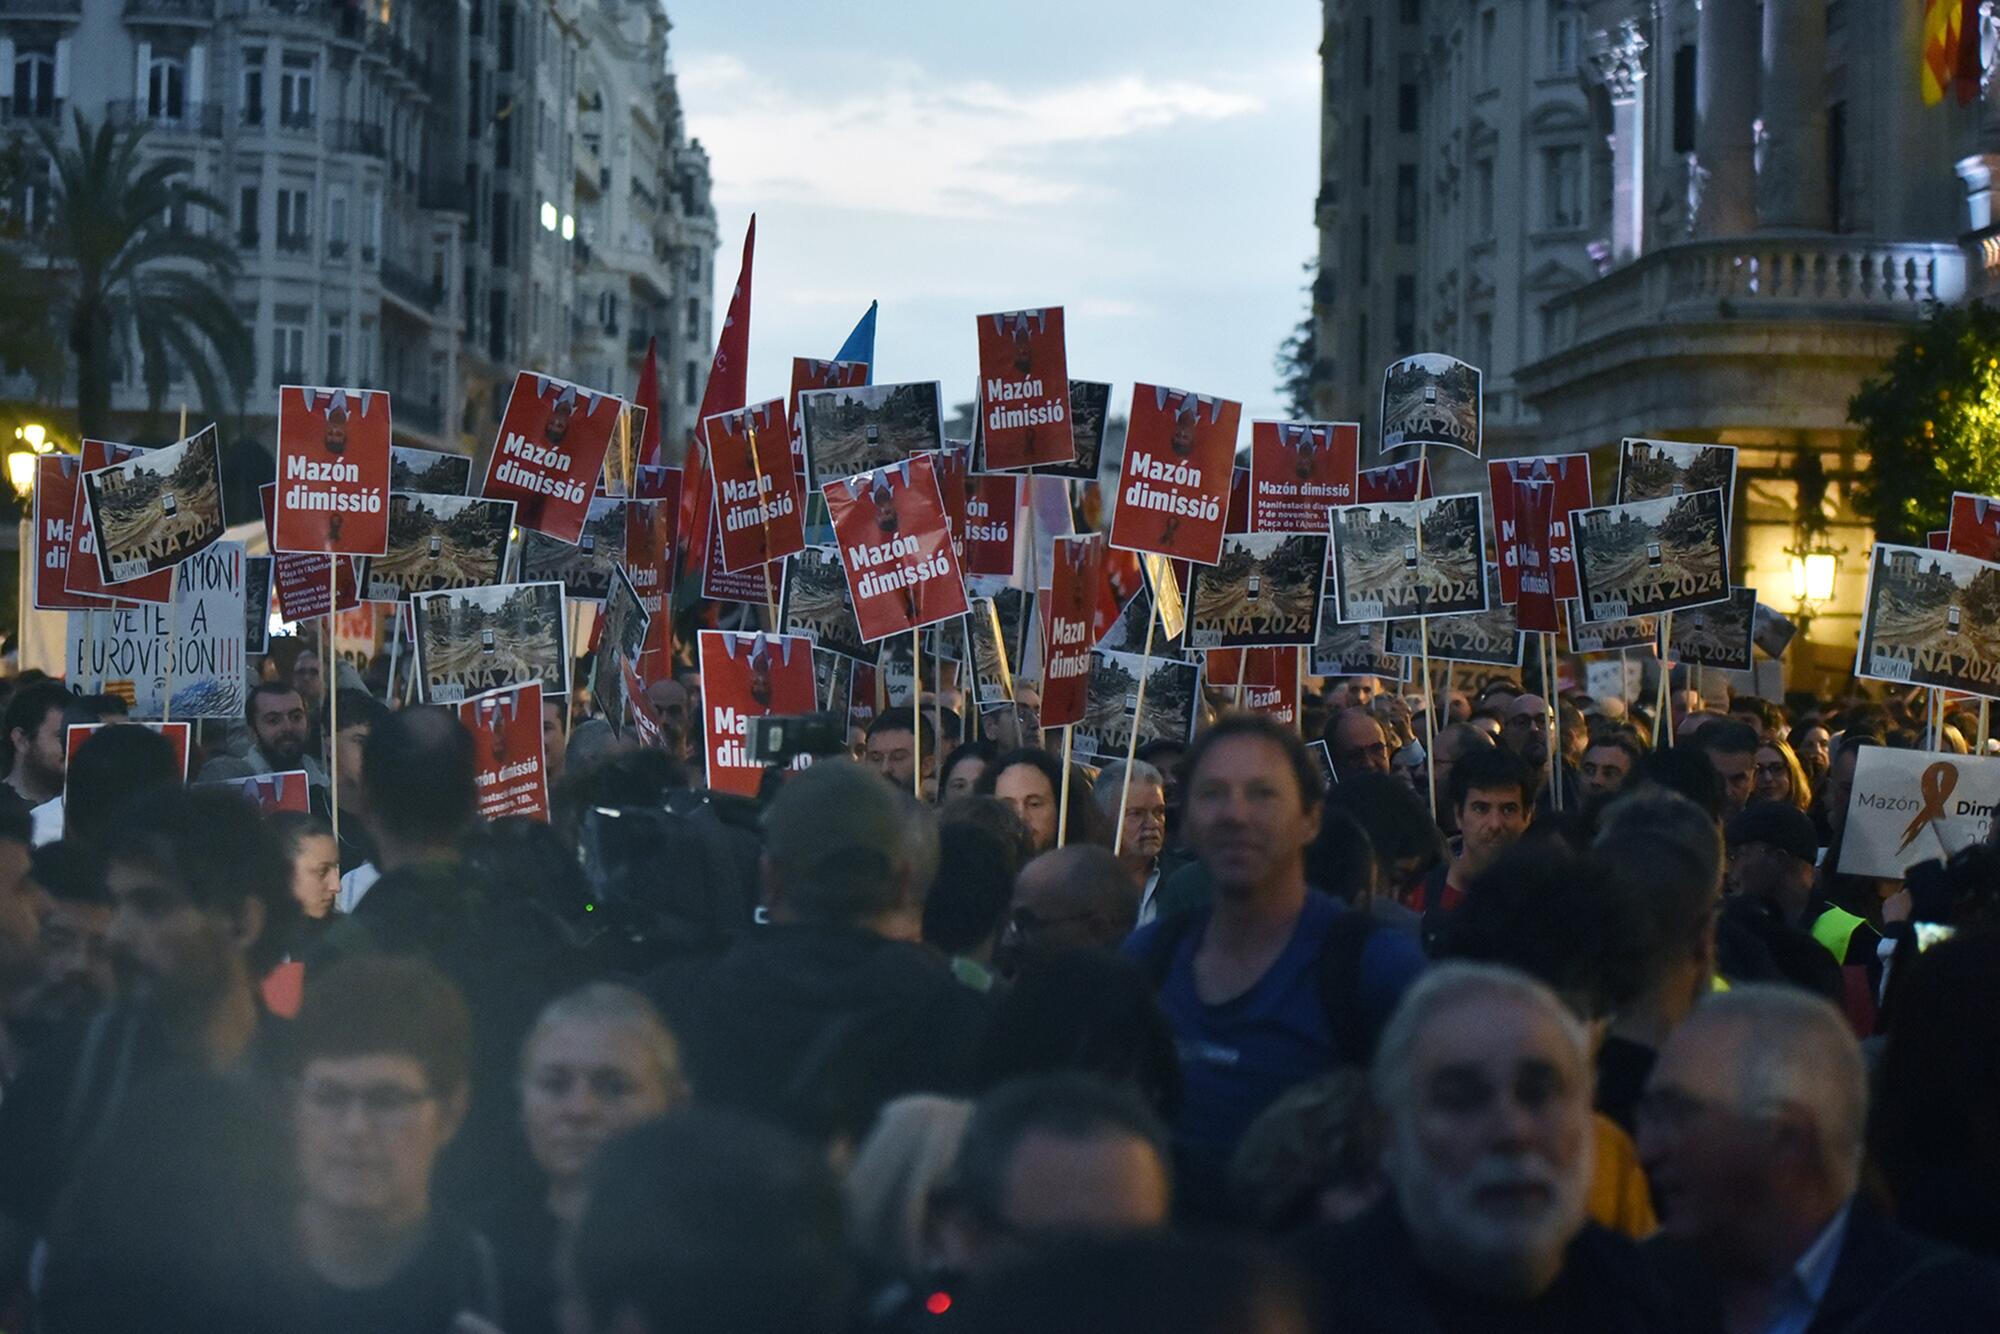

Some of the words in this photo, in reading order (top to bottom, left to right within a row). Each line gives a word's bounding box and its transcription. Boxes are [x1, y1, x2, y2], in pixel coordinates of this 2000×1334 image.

[987, 374, 1043, 402] Mazón
[989, 398, 1064, 430] dimissió
[1439, 420, 1476, 445] 2024
[503, 431, 572, 472] Mazón
[287, 455, 359, 483] Mazón
[496, 459, 587, 504] dimissió
[1130, 451, 1202, 488] Mazón
[285, 484, 381, 513] dimissió
[1125, 482, 1220, 521] dimissió
[1259, 480, 1297, 495] Mazón
[1300, 482, 1350, 498] dimissió
[1258, 520, 1281, 529] Plaça
[1283, 520, 1294, 528] de
[1265, 511, 1276, 519] de
[107, 535, 182, 568] DANA
[184, 512, 221, 547] 2024
[848, 531, 920, 571] Mazón
[857, 550, 950, 600] dimissió
[1589, 582, 1664, 607] DANA
[1669, 571, 1723, 600] 2024
[1346, 583, 1420, 607] DANA
[1425, 579, 1480, 604] 2024
[190, 598, 208, 634] A
[1192, 615, 1254, 637] DANA
[1258, 614, 1312, 635] 2024
[1870, 643, 1953, 676] DANA
[428, 668, 497, 690] DANA
[501, 663, 560, 687] 2024
[1857, 792, 1920, 811] Mazón
